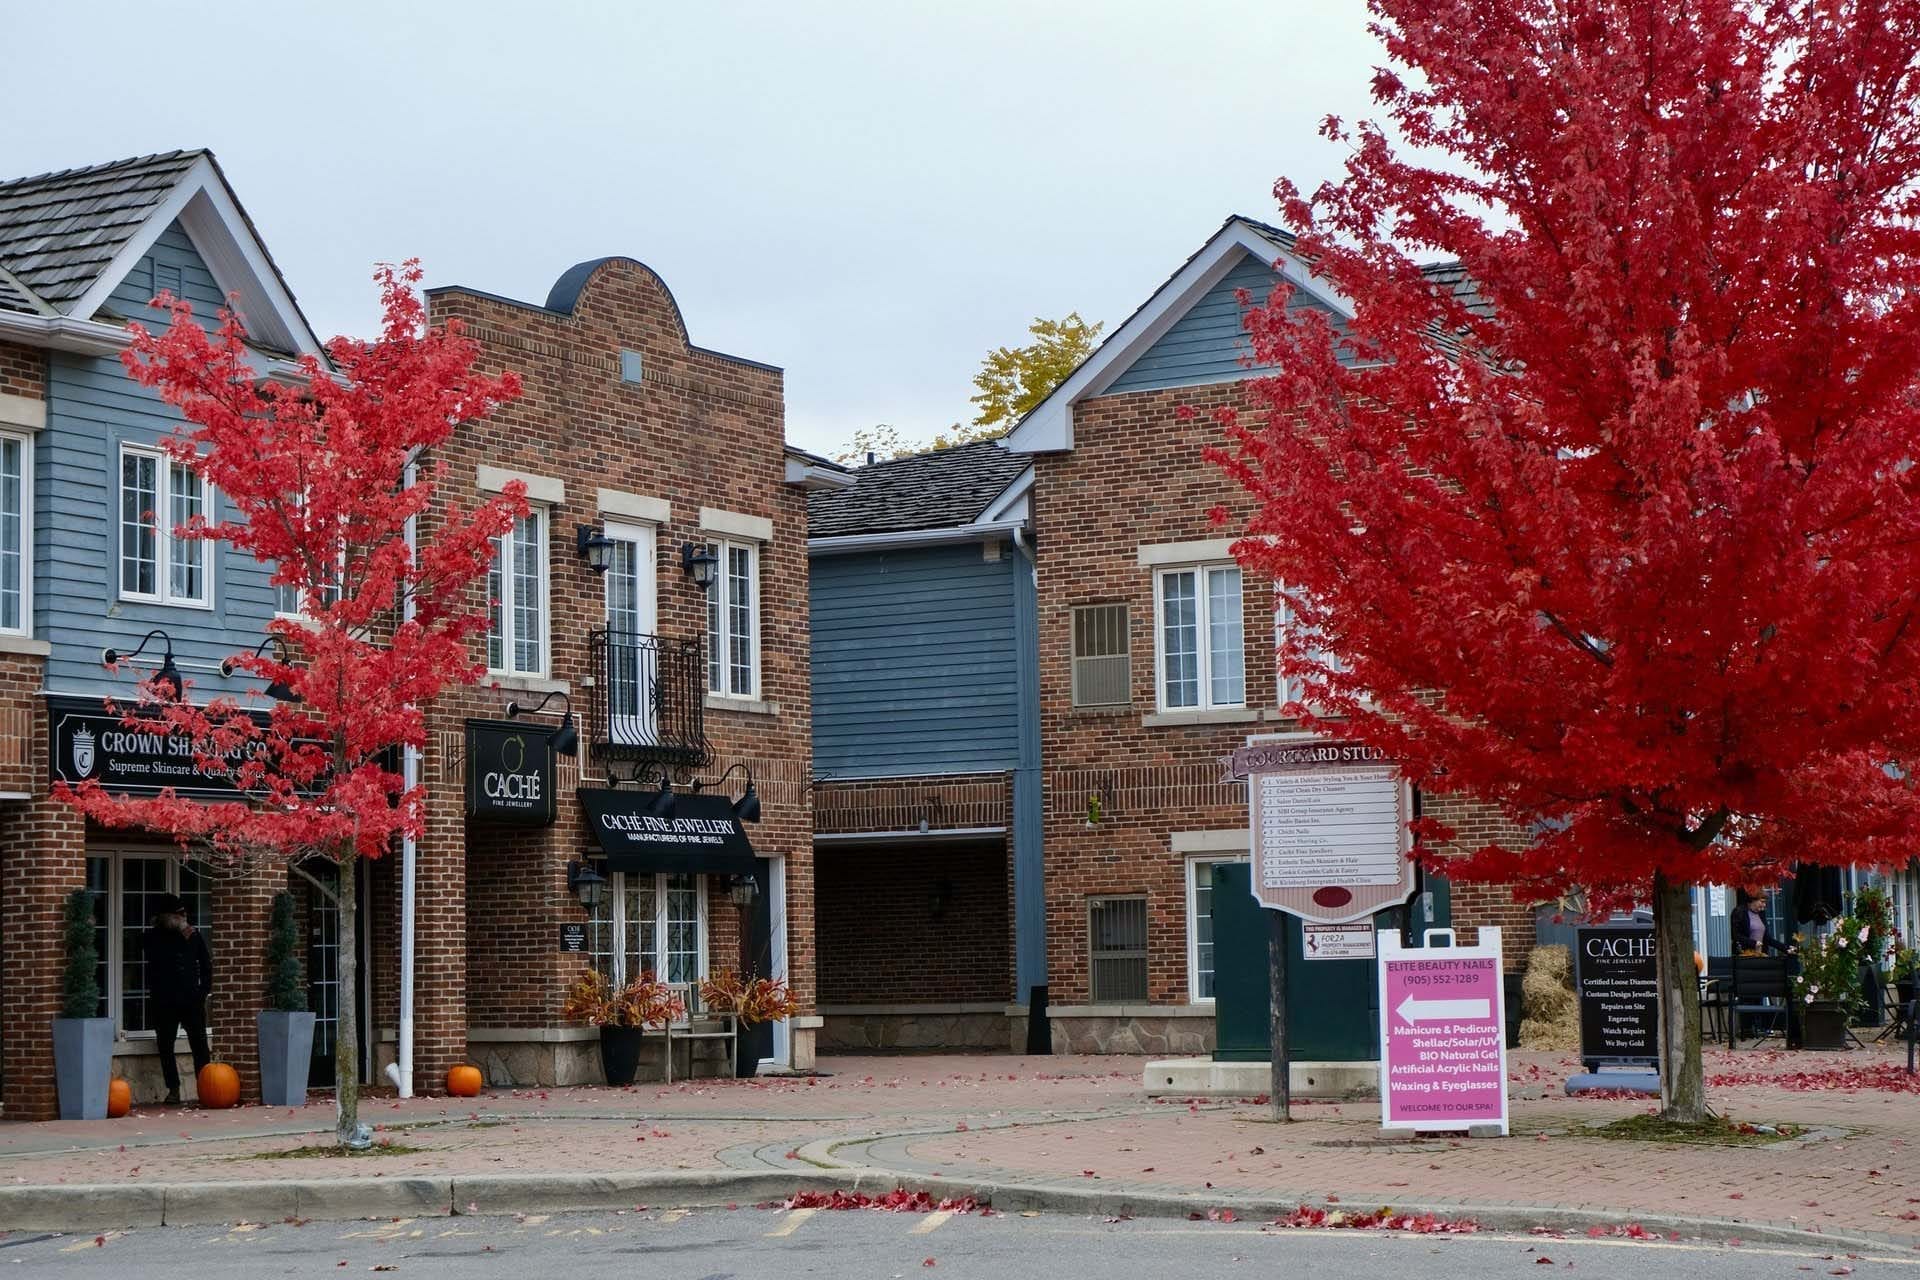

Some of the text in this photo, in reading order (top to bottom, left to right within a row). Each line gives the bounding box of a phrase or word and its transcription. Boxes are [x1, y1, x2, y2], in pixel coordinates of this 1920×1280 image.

[102, 731, 163, 755] CROWN
[1246, 745, 1410, 767] COURTYARD STUD
[109, 759, 150, 774] Supreme
[152, 762, 191, 775] Skincare
[192, 764, 201, 776] &
[484, 769, 541, 800] CACHÉ
[492, 799, 533, 808] FINE JEWELLERY
[601, 811, 735, 835] CACHÉ FINE JEWELLERY
[626, 832, 680, 844] MANUFACTURERS
[687, 834, 702, 844] FINE
[1321, 933, 1345, 943] FORZA
[1586, 933, 1656, 957] CACHÉ
[1388, 960, 1494, 972] ELITE BEAUTY NAILS
[1403, 974, 1479, 986] (905) 552-1289
[1583, 978, 1610, 986] Certified
[1610, 978, 1629, 986] Loose
[1585, 990, 1610, 998] Custom
[1610, 990, 1632, 1000] Design
[1601, 1003, 1625, 1012] Repairs
[1608, 1015, 1640, 1024] Engraving
[1394, 1024, 1498, 1036] Manicure & Pedicure
[1602, 1027, 1646, 1036] Watch Repairs
[1412, 1037, 1497, 1049] Shellac/Solar/UV
[1605, 1039, 1645, 1049] We Buy Gold
[1420, 1049, 1499, 1061] BIO Natural Gel
[1391, 1062, 1499, 1075] Artificial Acrylic Nails
[1391, 1080, 1498, 1093] Waxing & Eyeglasses
[1400, 1103, 1494, 1112] WELCOME TO OUR SPA!
